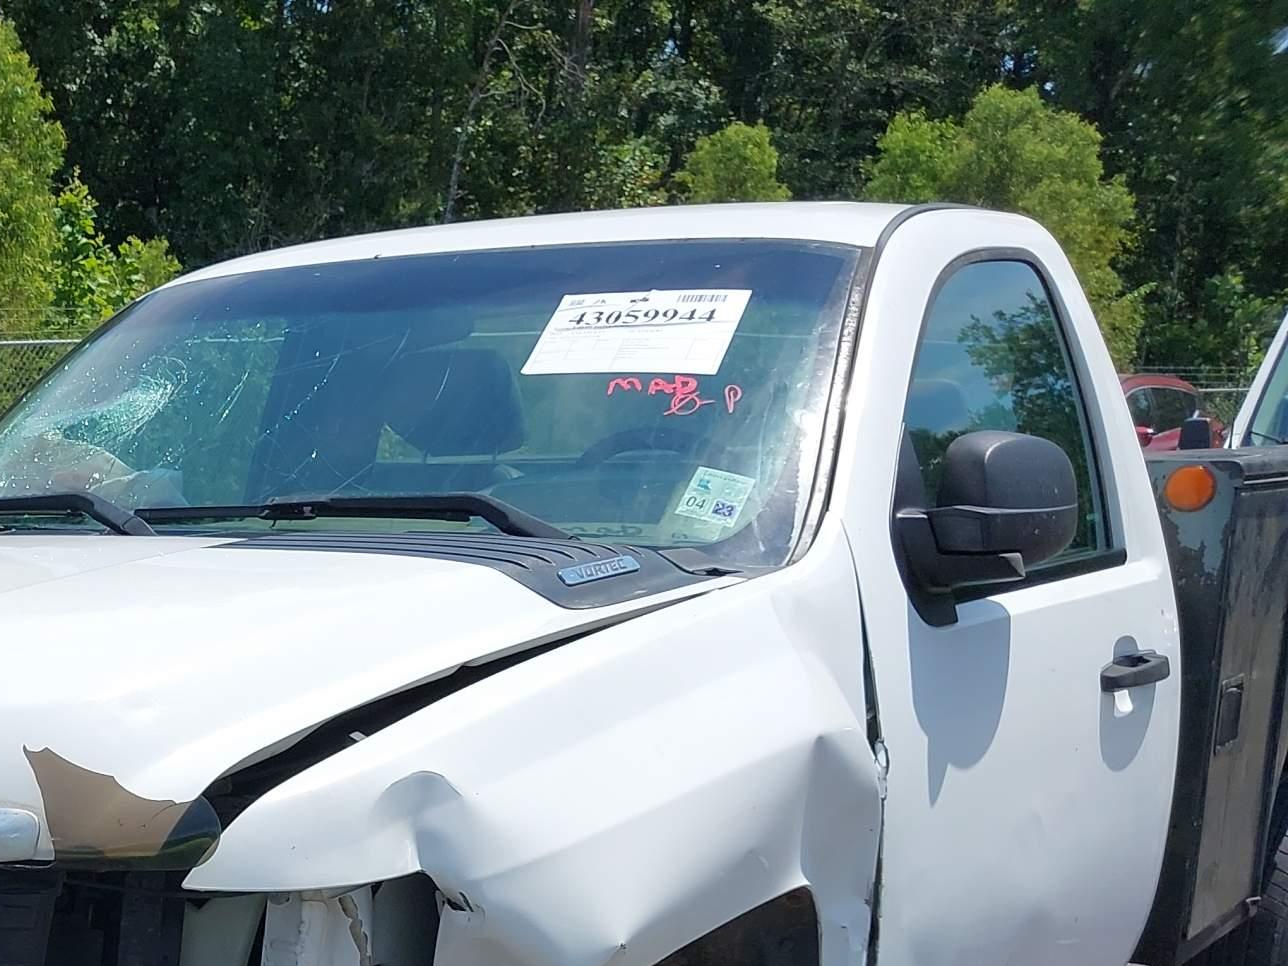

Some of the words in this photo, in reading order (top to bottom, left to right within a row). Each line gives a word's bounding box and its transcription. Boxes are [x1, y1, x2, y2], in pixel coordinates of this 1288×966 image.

[569, 307, 716, 325] 43059944
[686, 496, 706, 510] 04
[575, 559, 627, 579] VORTEC
